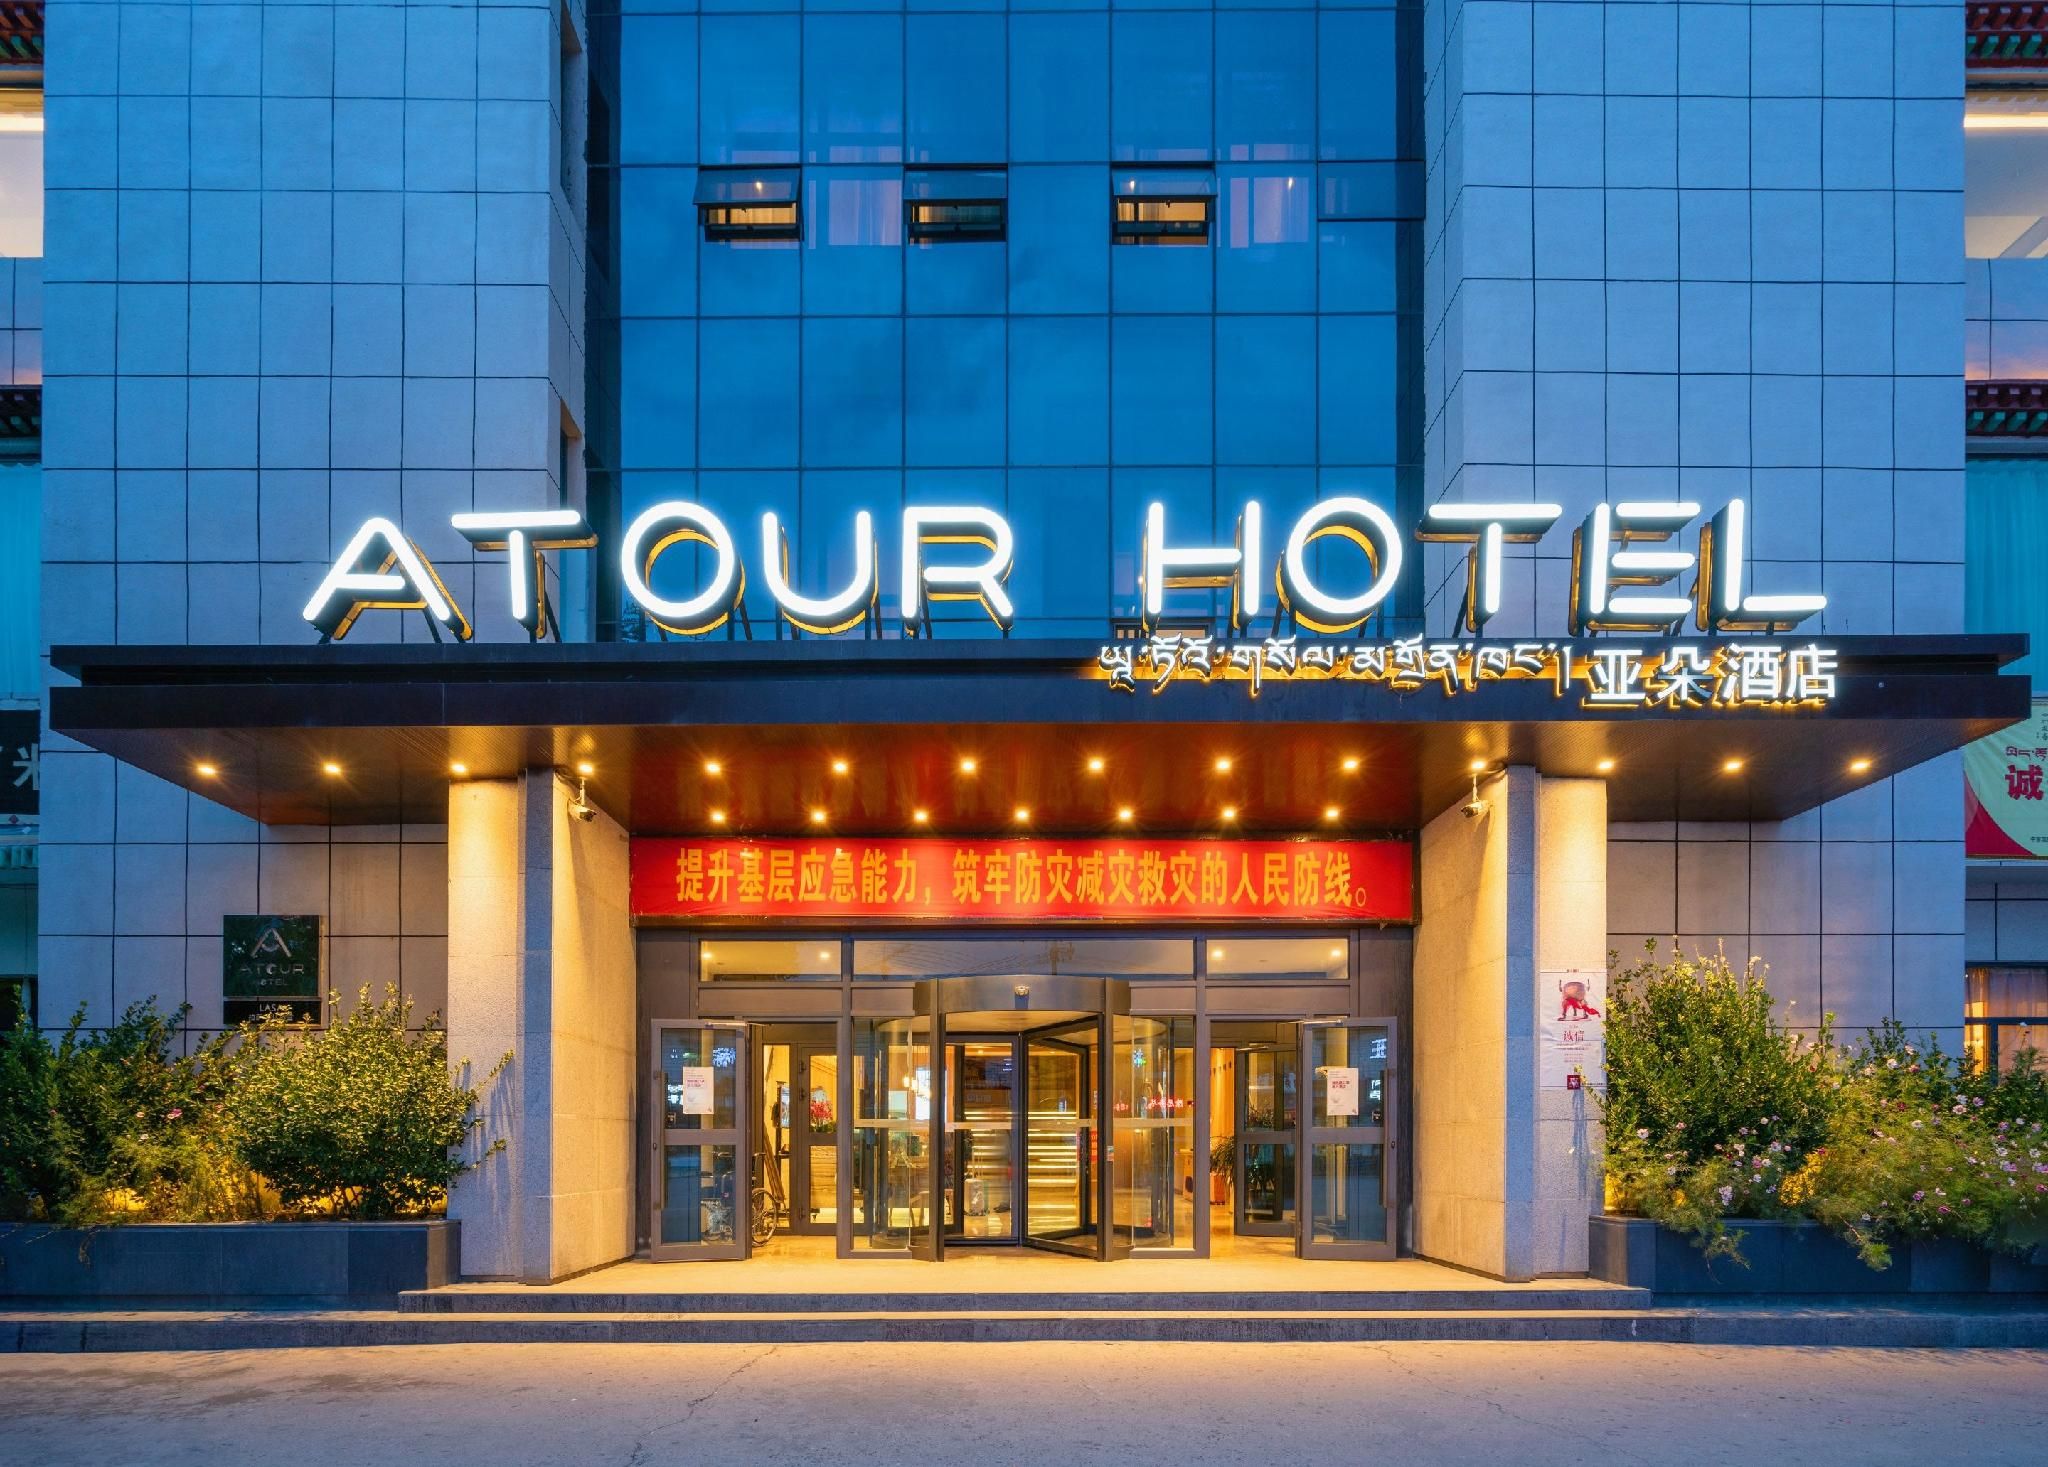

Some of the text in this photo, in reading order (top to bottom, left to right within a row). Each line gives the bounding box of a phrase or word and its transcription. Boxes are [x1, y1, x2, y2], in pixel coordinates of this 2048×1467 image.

[303, 497, 1828, 622] ATOUR HOTEL
[1590, 643, 1839, 701] 亚朵酒店
